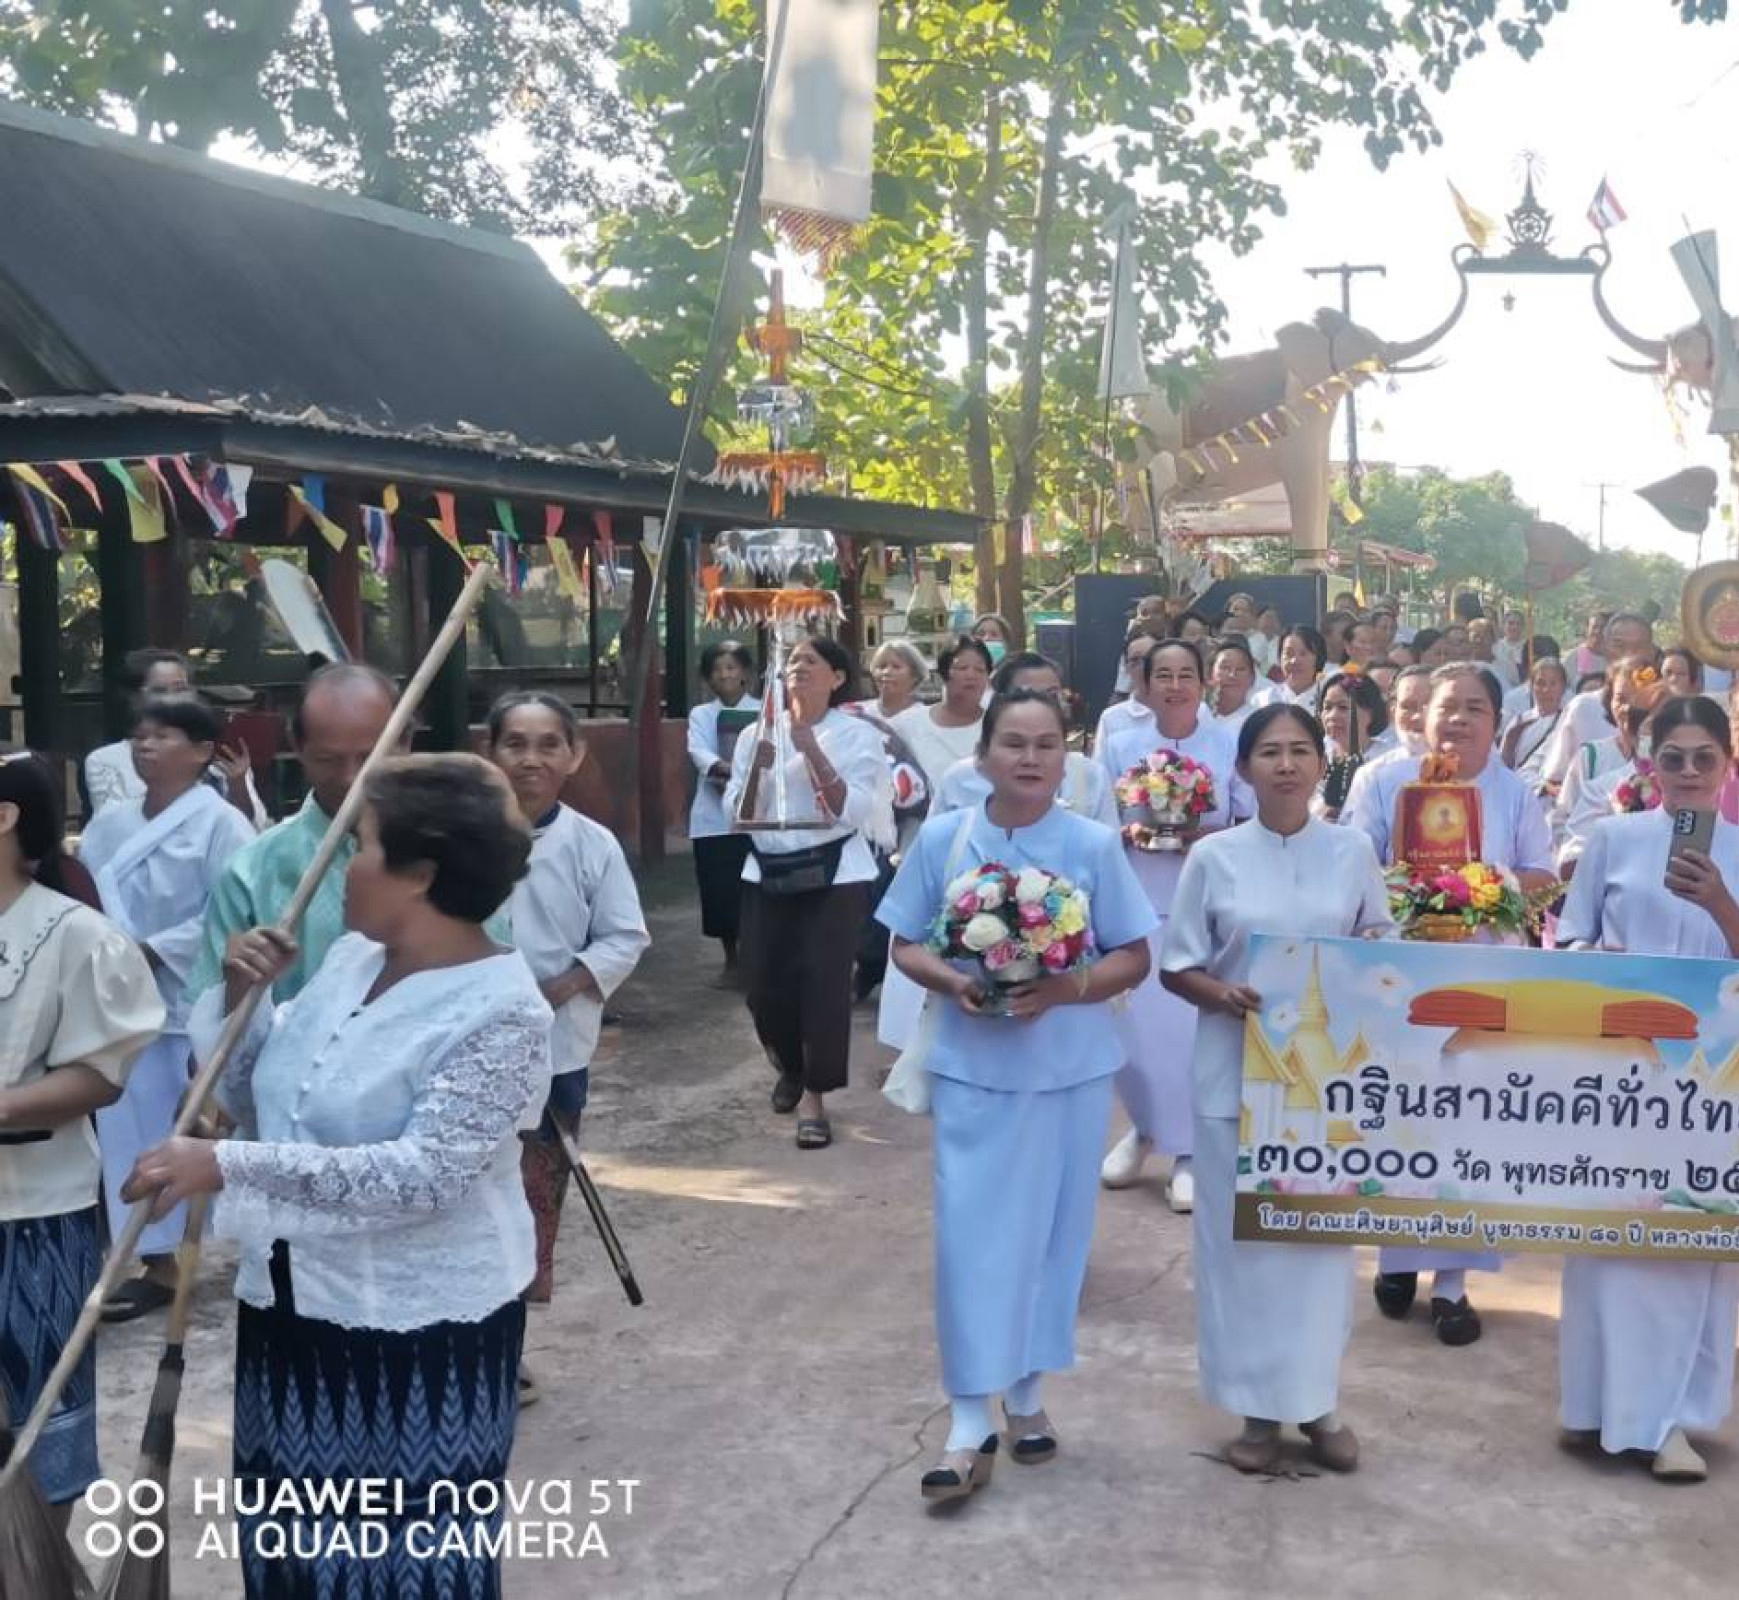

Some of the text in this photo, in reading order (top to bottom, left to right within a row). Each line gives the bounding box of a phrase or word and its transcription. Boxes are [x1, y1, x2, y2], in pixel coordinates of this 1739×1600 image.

[1256, 1143, 1439, 1182] ๓๐,๐๐๐
[1452, 1148, 1492, 1182] วัด
[1501, 1154, 1671, 1196] พุทธศักราช
[1258, 1204, 1300, 1229] โดย
[1306, 1209, 1475, 1243] คณะศิษยานุศิษย์
[1482, 1219, 1581, 1245] บูชาธรรม
[1627, 1221, 1643, 1245] ปี
